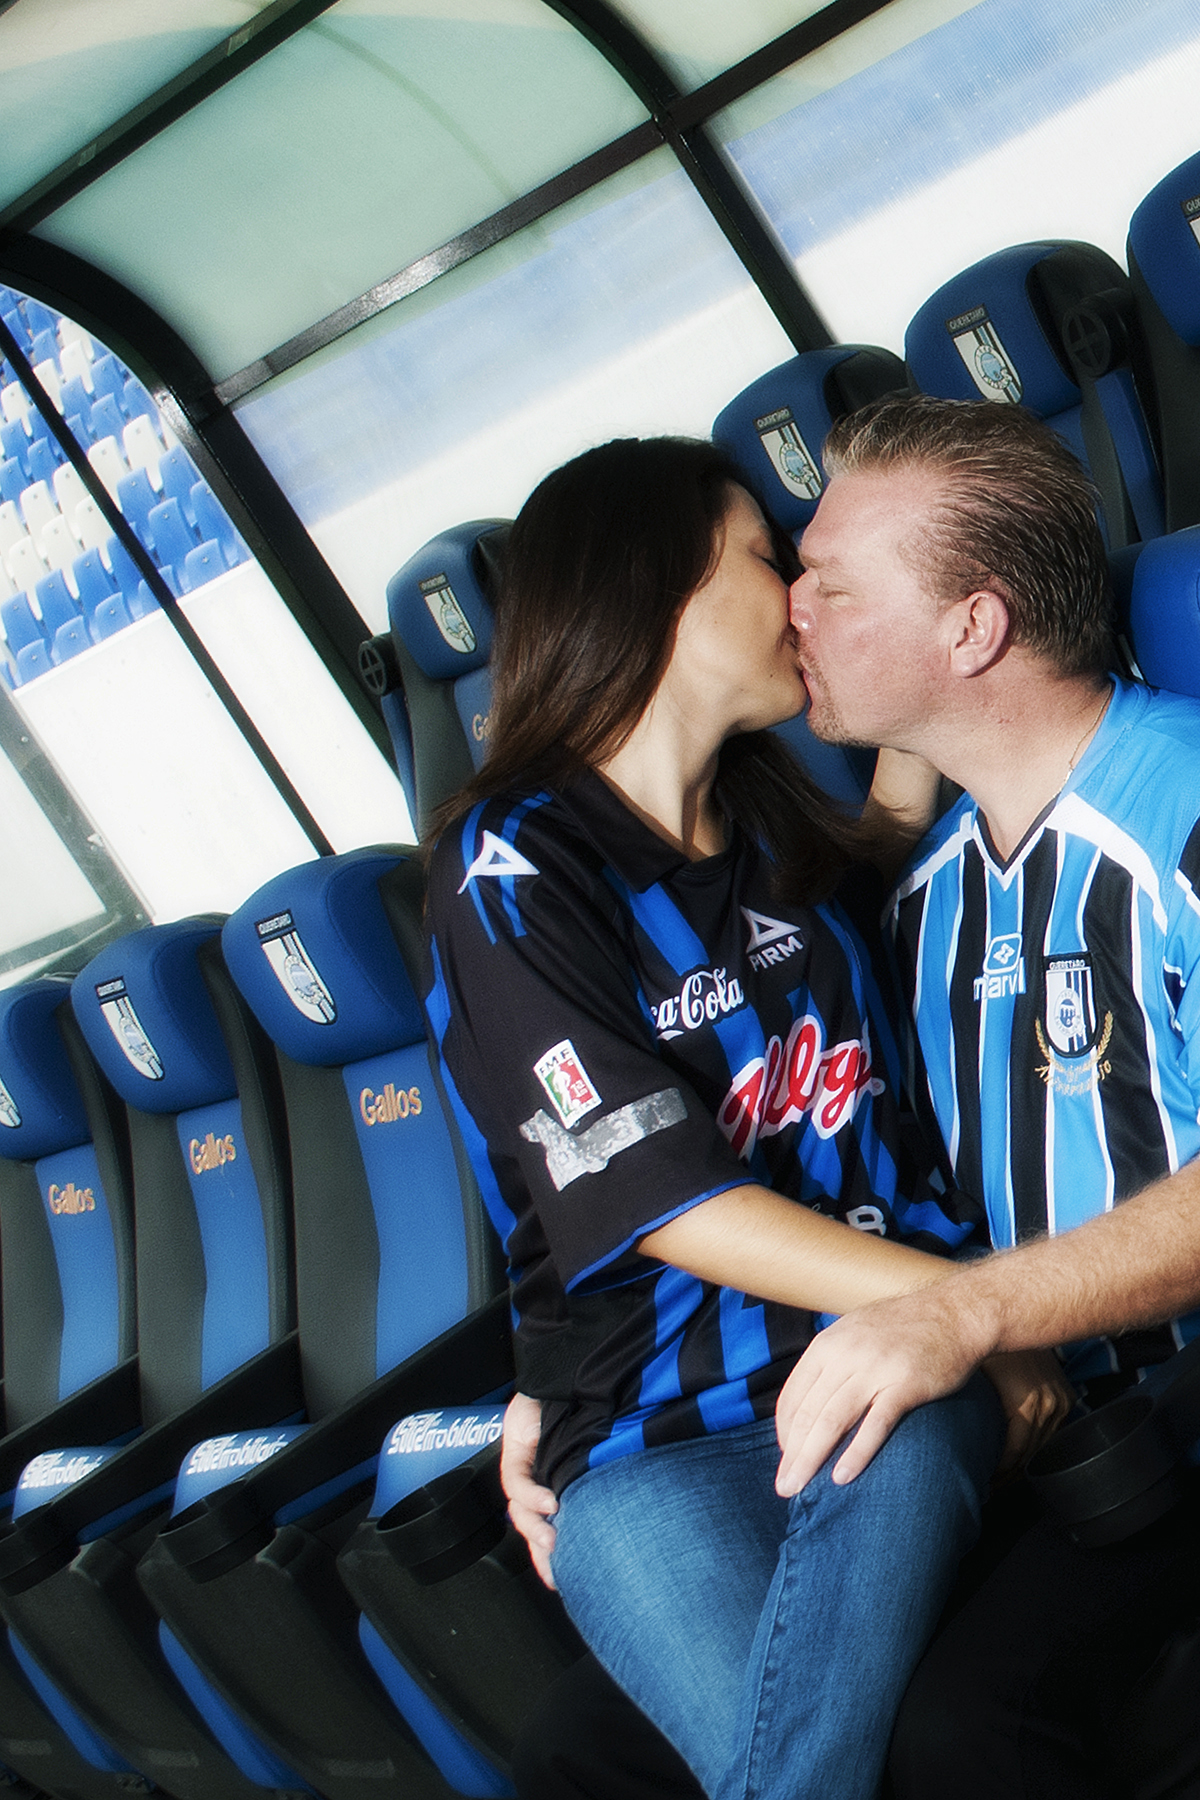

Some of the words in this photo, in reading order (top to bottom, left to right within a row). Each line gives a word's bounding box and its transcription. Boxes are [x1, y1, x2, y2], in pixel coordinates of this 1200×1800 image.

[747, 935, 804, 973] PIRM
[539, 1048, 571, 1076] FMF
[360, 1083, 422, 1127] Gallos
[189, 1132, 237, 1175] Gallos
[48, 1182, 96, 1215] Gallos
